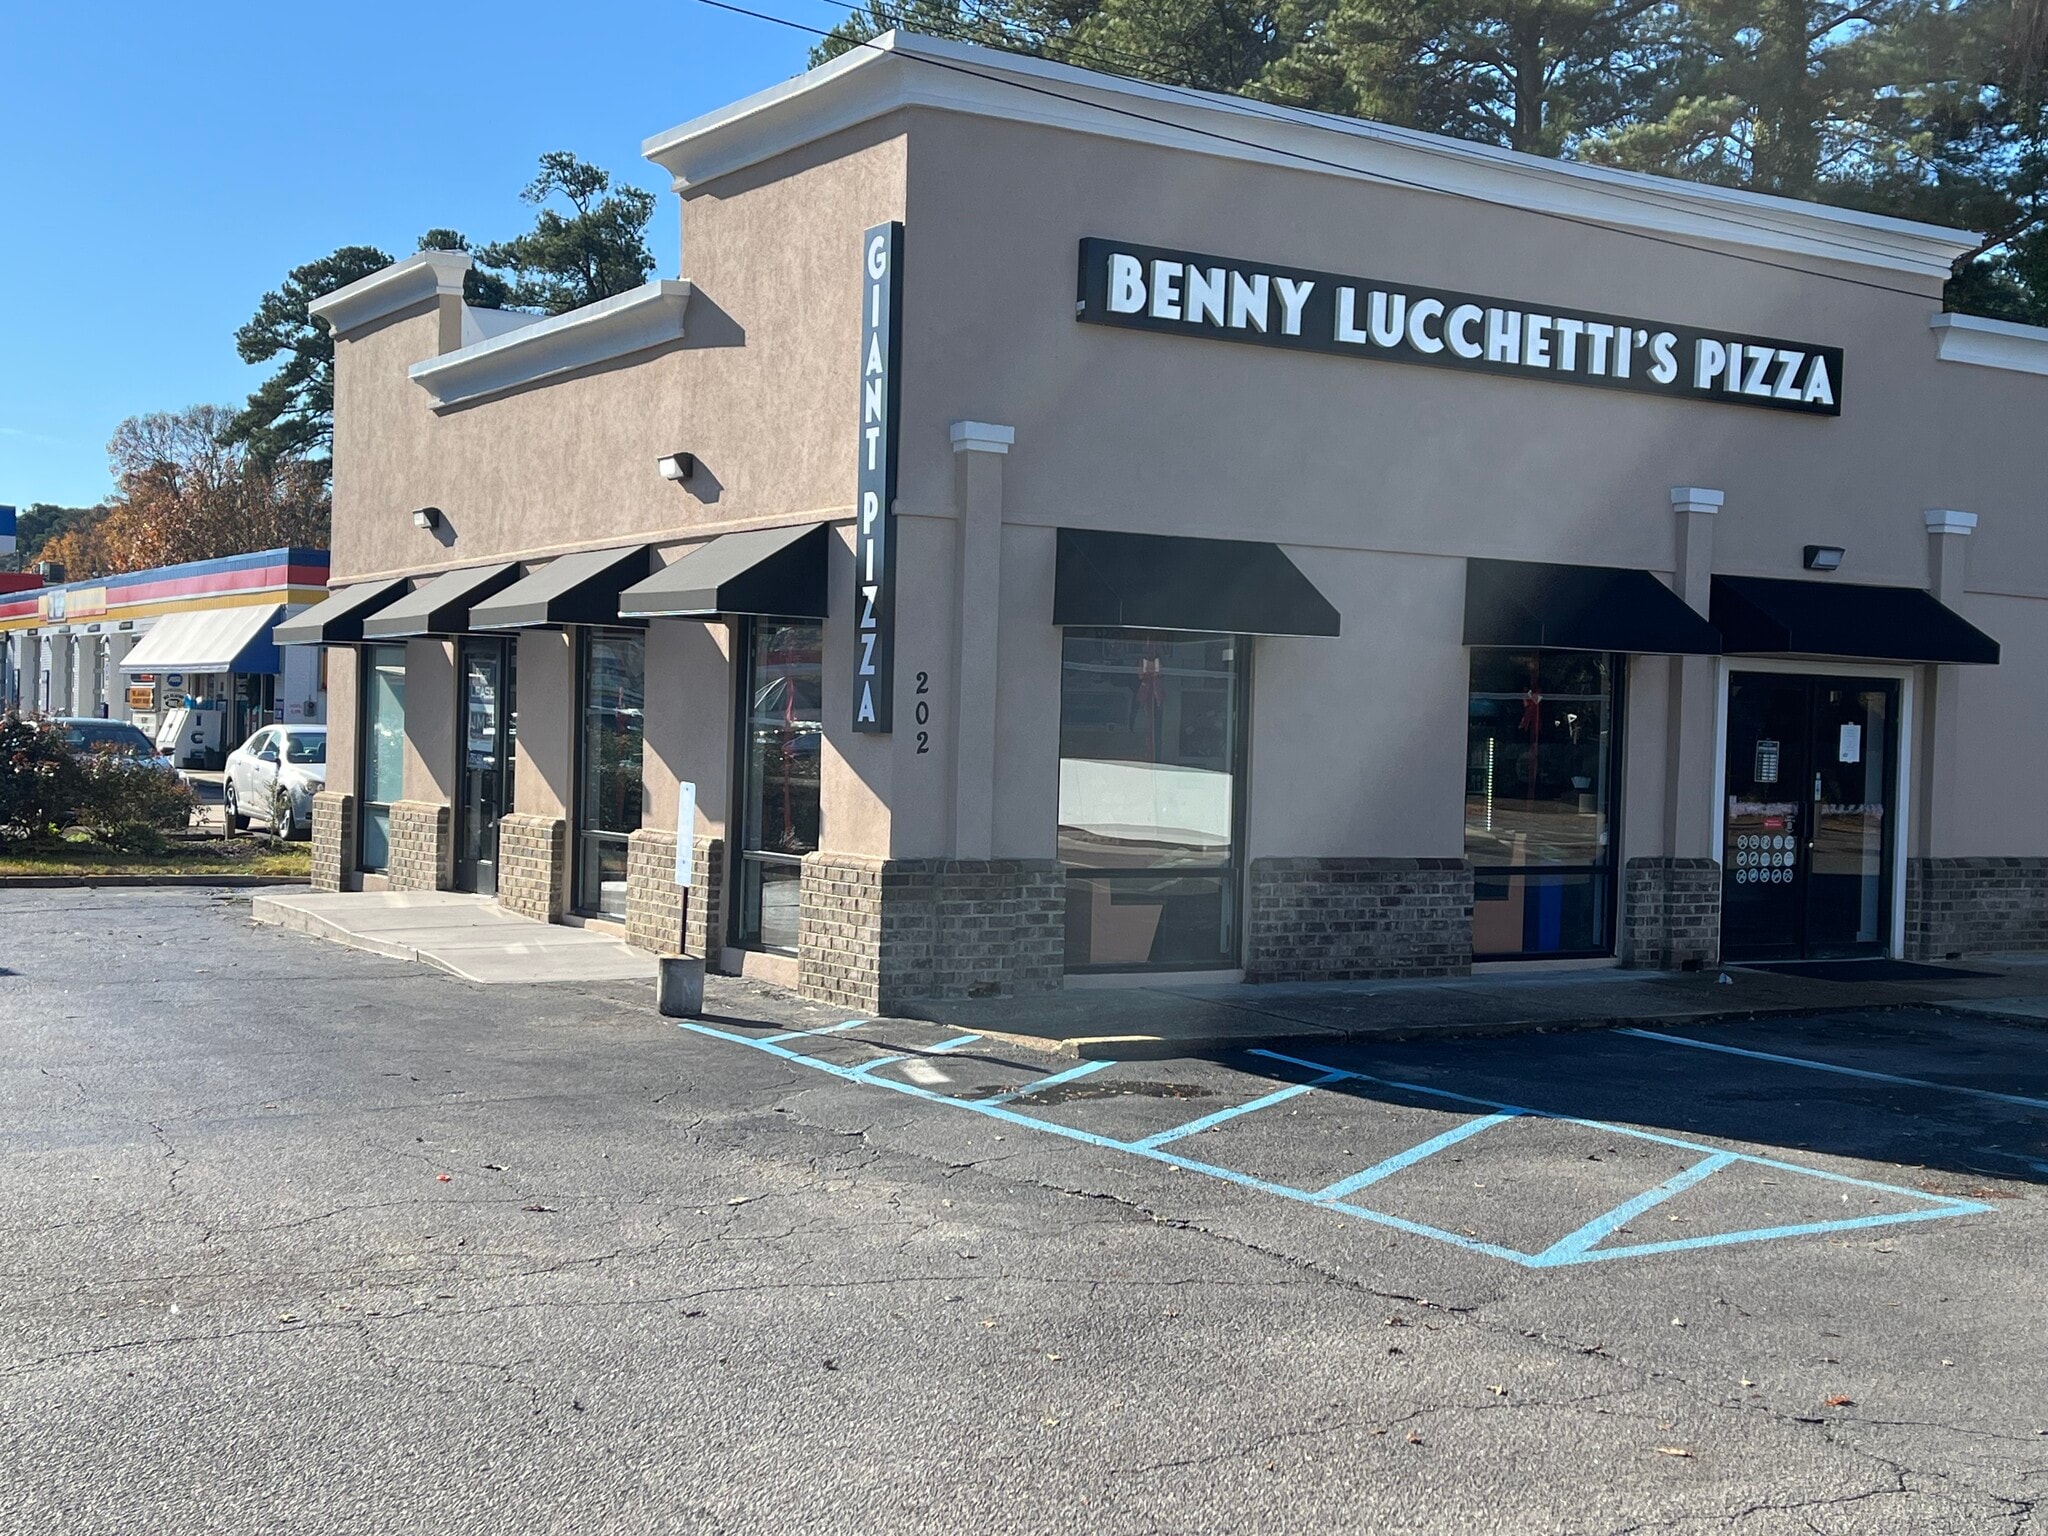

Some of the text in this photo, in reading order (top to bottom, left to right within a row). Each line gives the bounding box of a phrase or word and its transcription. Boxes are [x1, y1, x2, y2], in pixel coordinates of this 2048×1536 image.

[1106, 253, 1835, 404] BENNY LUCCHETTI'S PIZZA
[857, 235, 887, 723] GIANT PIZZA
[915, 671, 929, 755] 202
